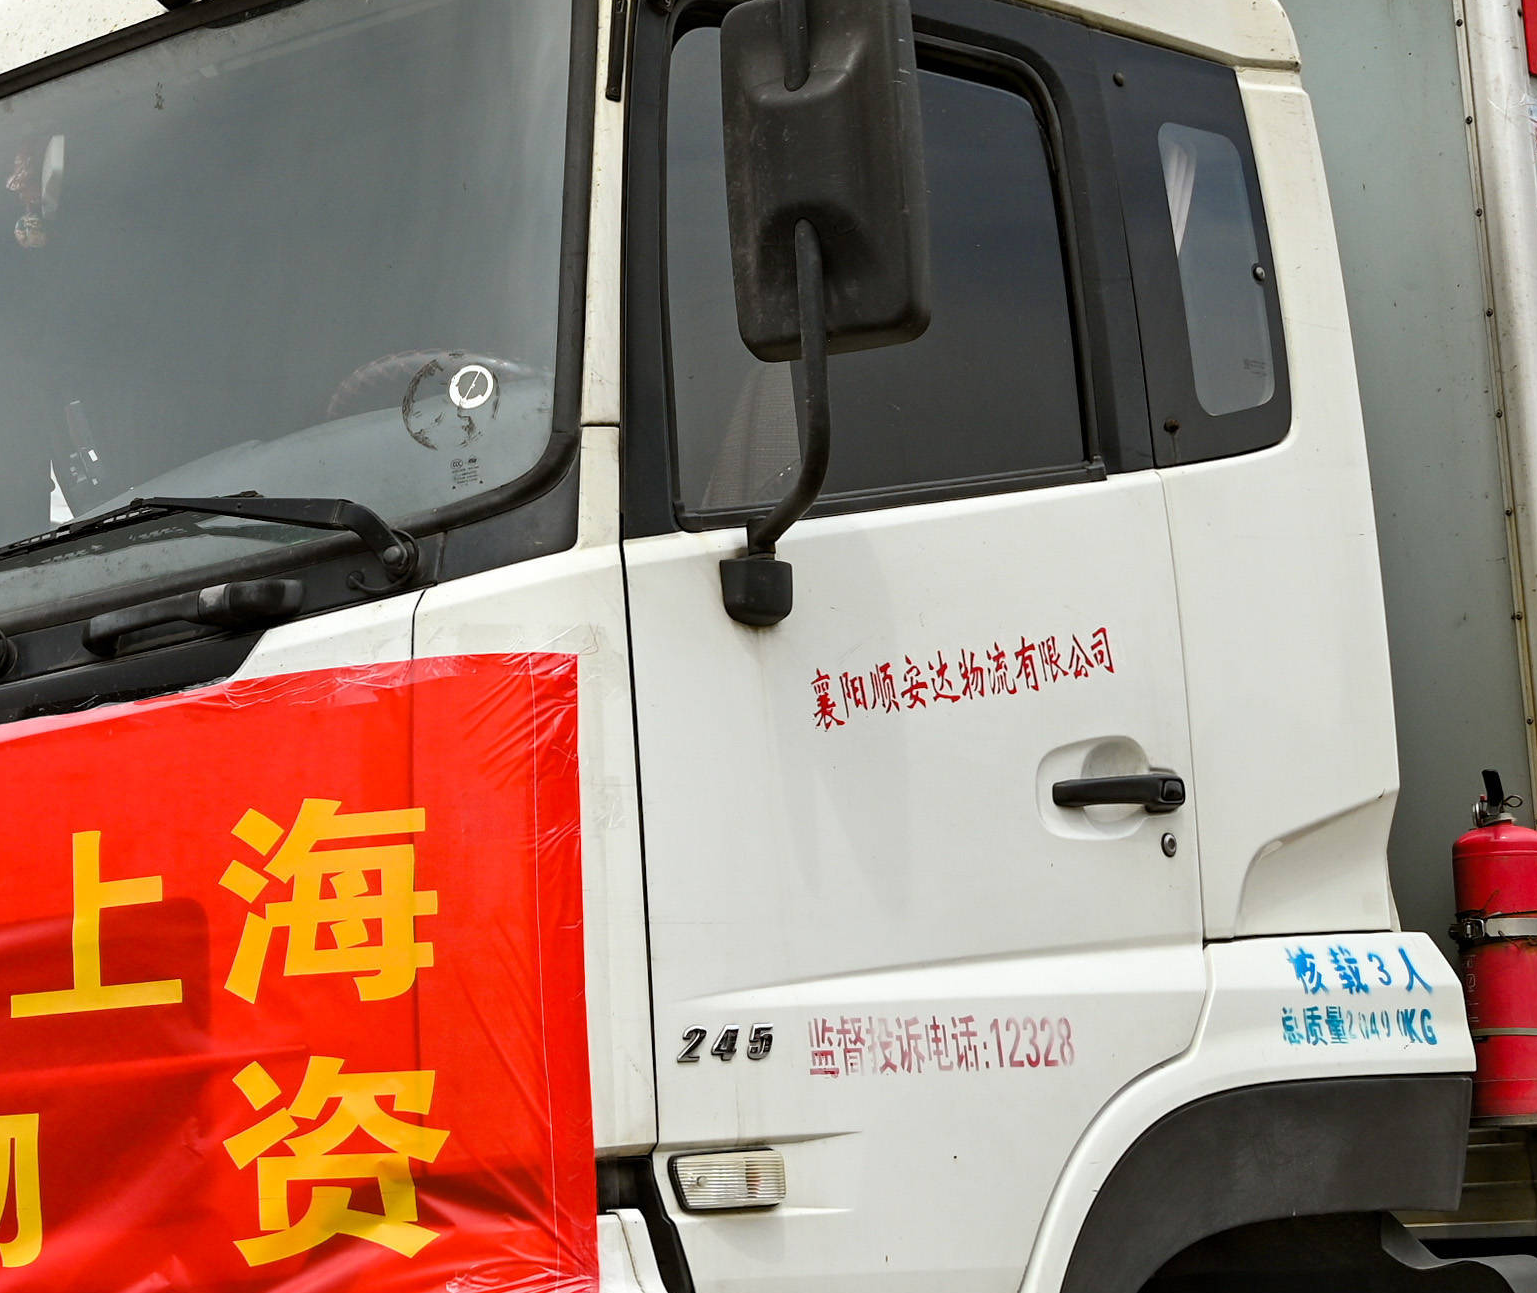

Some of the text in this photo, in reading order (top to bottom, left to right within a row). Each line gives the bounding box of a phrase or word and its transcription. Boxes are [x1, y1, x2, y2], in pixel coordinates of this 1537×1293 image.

[809, 627, 1115, 732] 襄阳顺安达物流有限公司
[677, 1024, 774, 1063] 245
